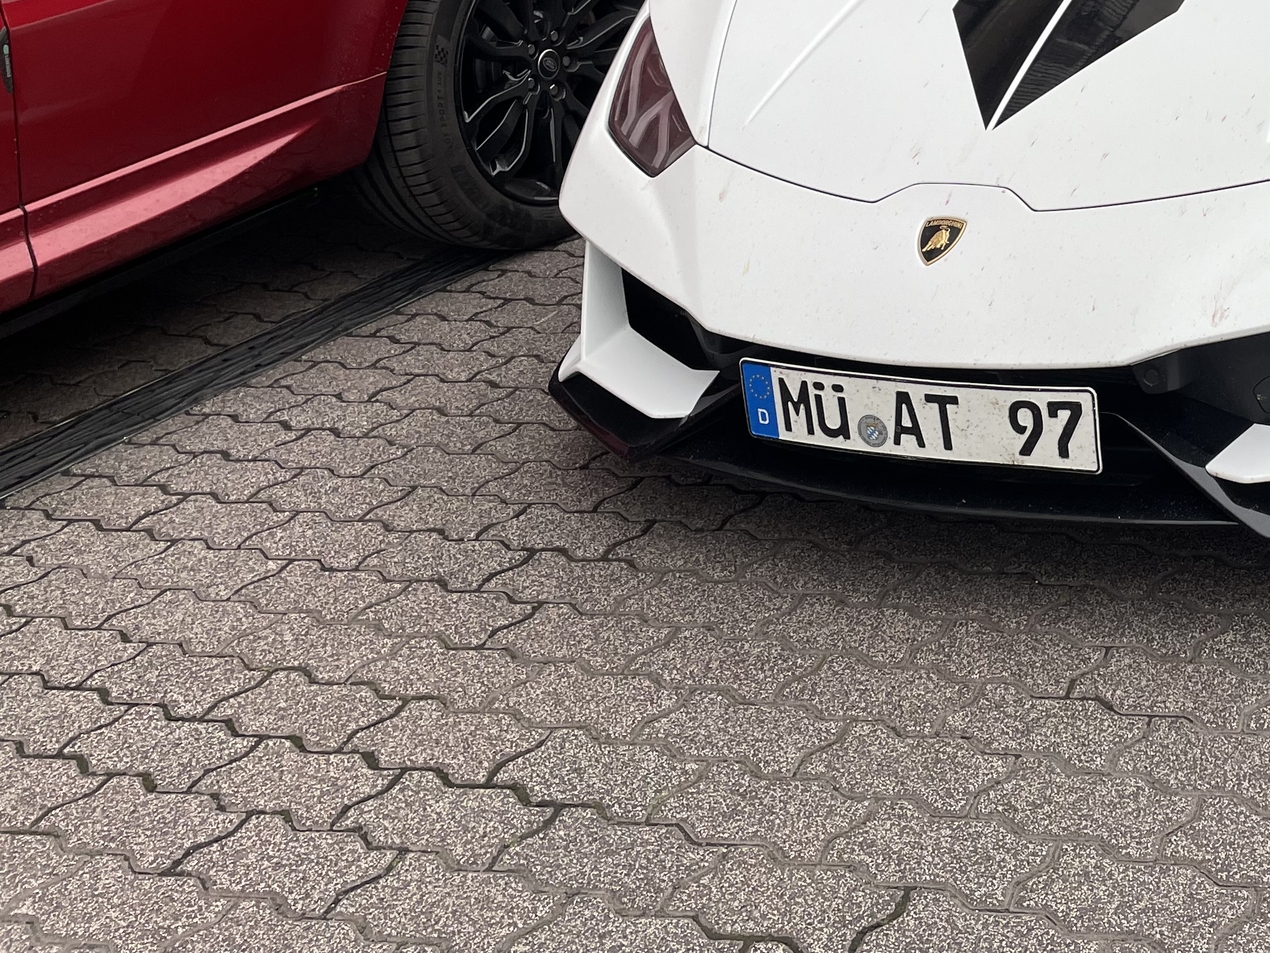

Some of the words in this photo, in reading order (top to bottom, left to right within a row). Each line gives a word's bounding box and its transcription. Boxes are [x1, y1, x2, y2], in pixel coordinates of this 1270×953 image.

[757, 407, 770, 425] D
[778, 377, 851, 441] MÜ
[893, 390, 959, 451] AT
[1008, 400, 1084, 459] 97
